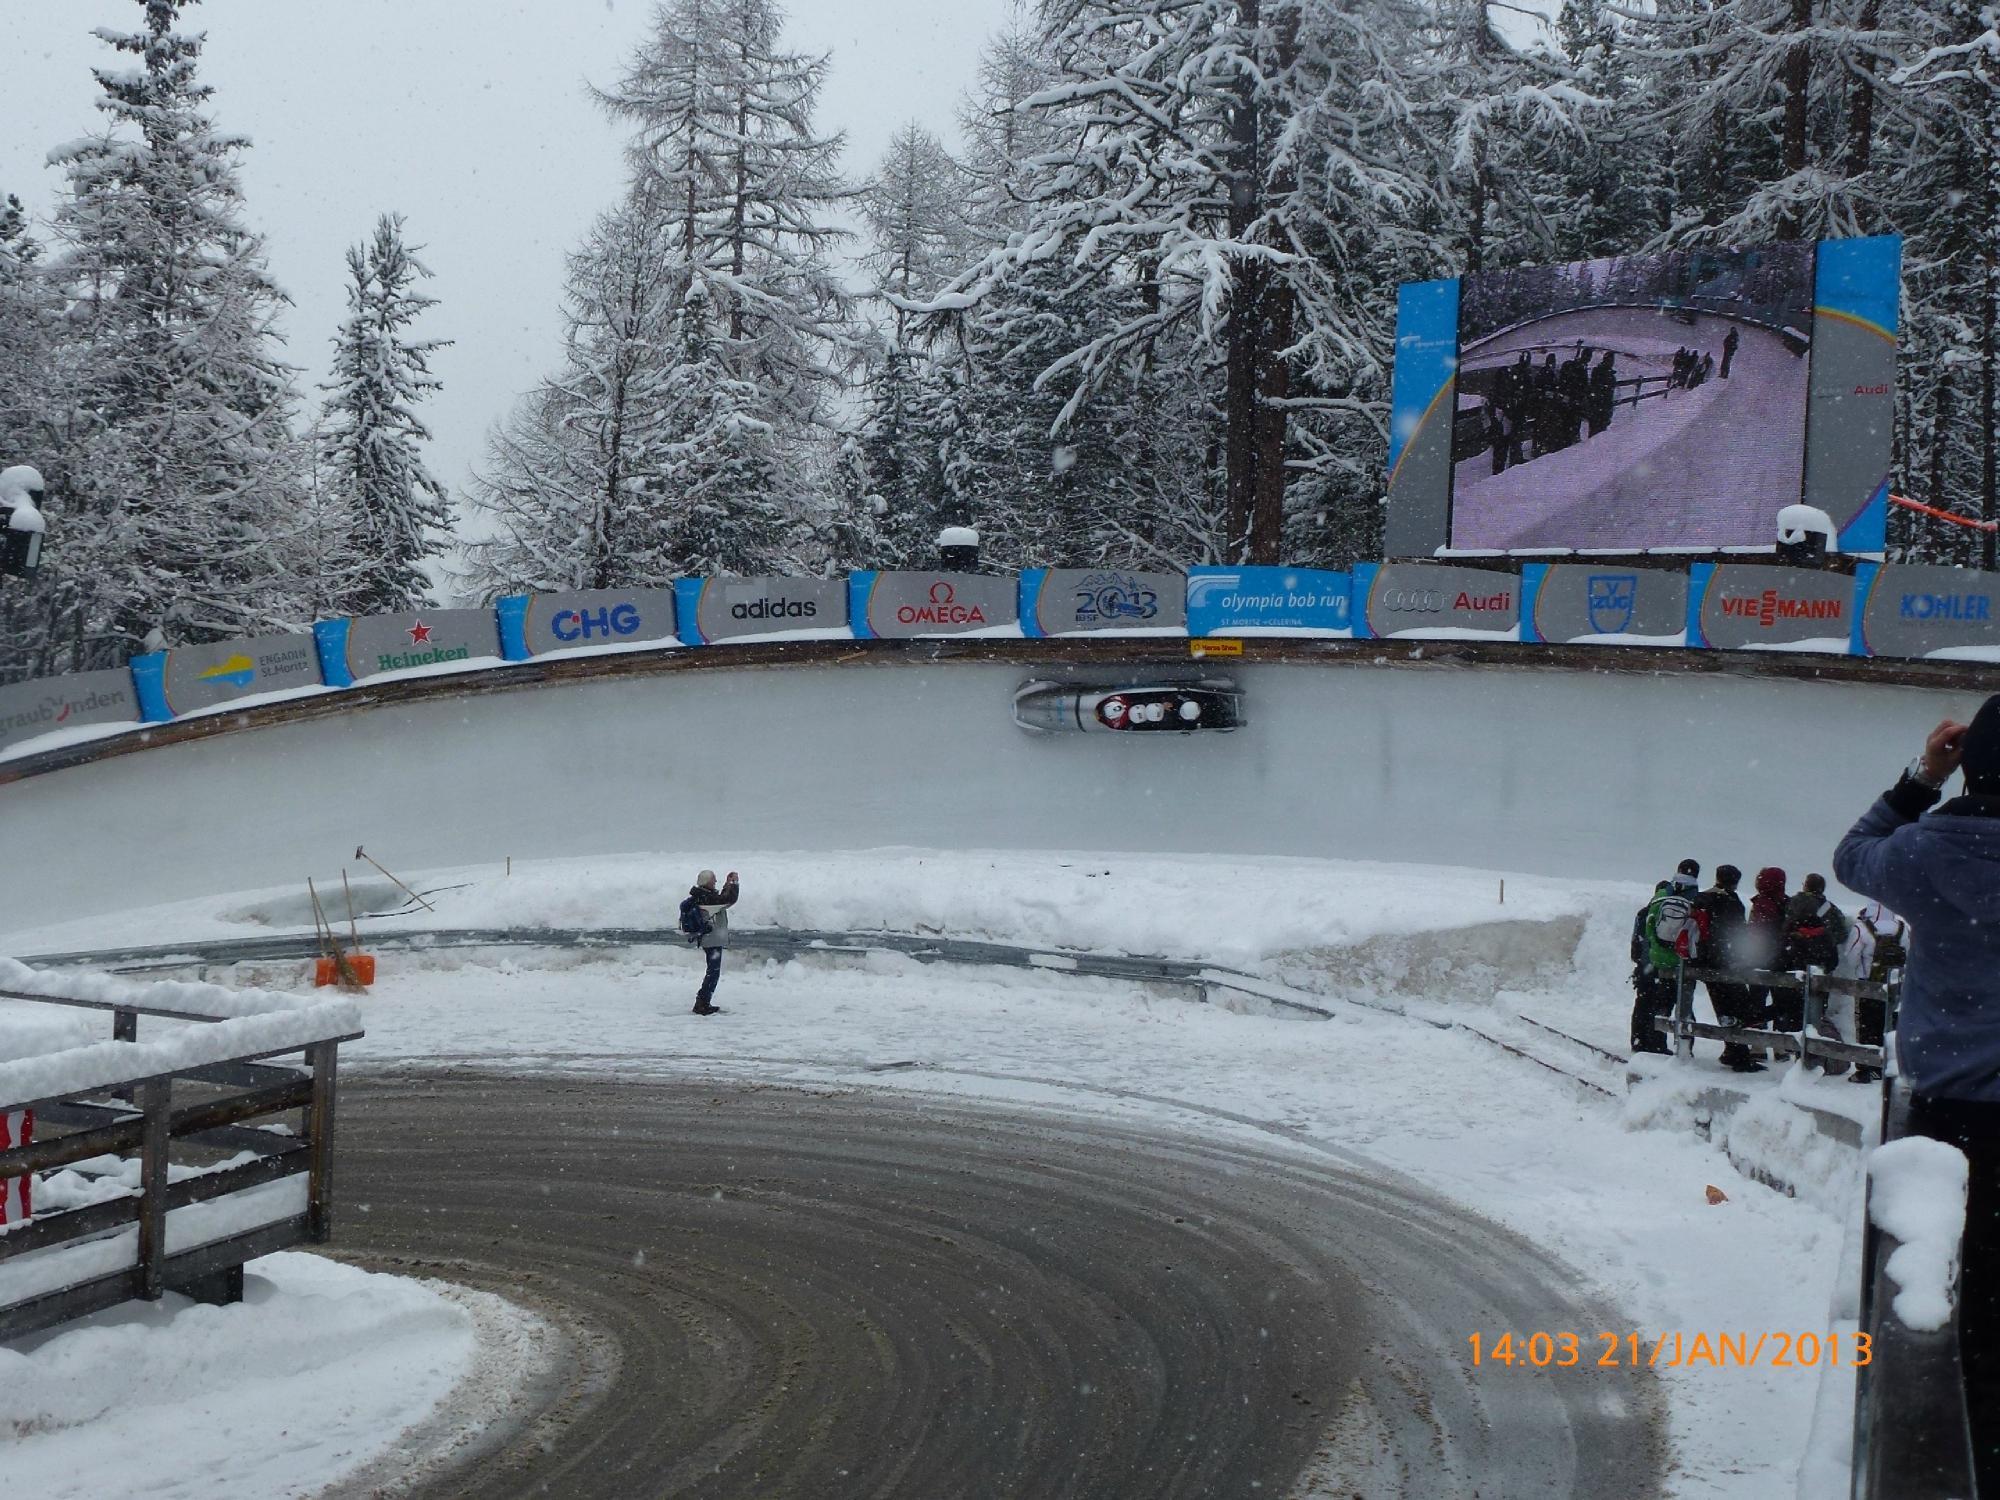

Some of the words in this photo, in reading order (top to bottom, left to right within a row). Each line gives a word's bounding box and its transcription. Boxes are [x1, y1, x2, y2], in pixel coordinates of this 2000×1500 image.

[1854, 384, 1888, 395] Audi
[731, 597, 817, 619] adidas
[1075, 588, 1159, 619] 2013
[1222, 593, 1284, 613] olympia
[1288, 592, 1316, 608] bob
[1319, 595, 1345, 608] run
[1453, 592, 1511, 611] Audi
[1900, 593, 1991, 620] KOHLER
[551, 603, 641, 641] CHG
[897, 605, 985, 624] OMEGA
[258, 648, 307, 667] ENGADIN
[377, 647, 470, 671] Heineken
